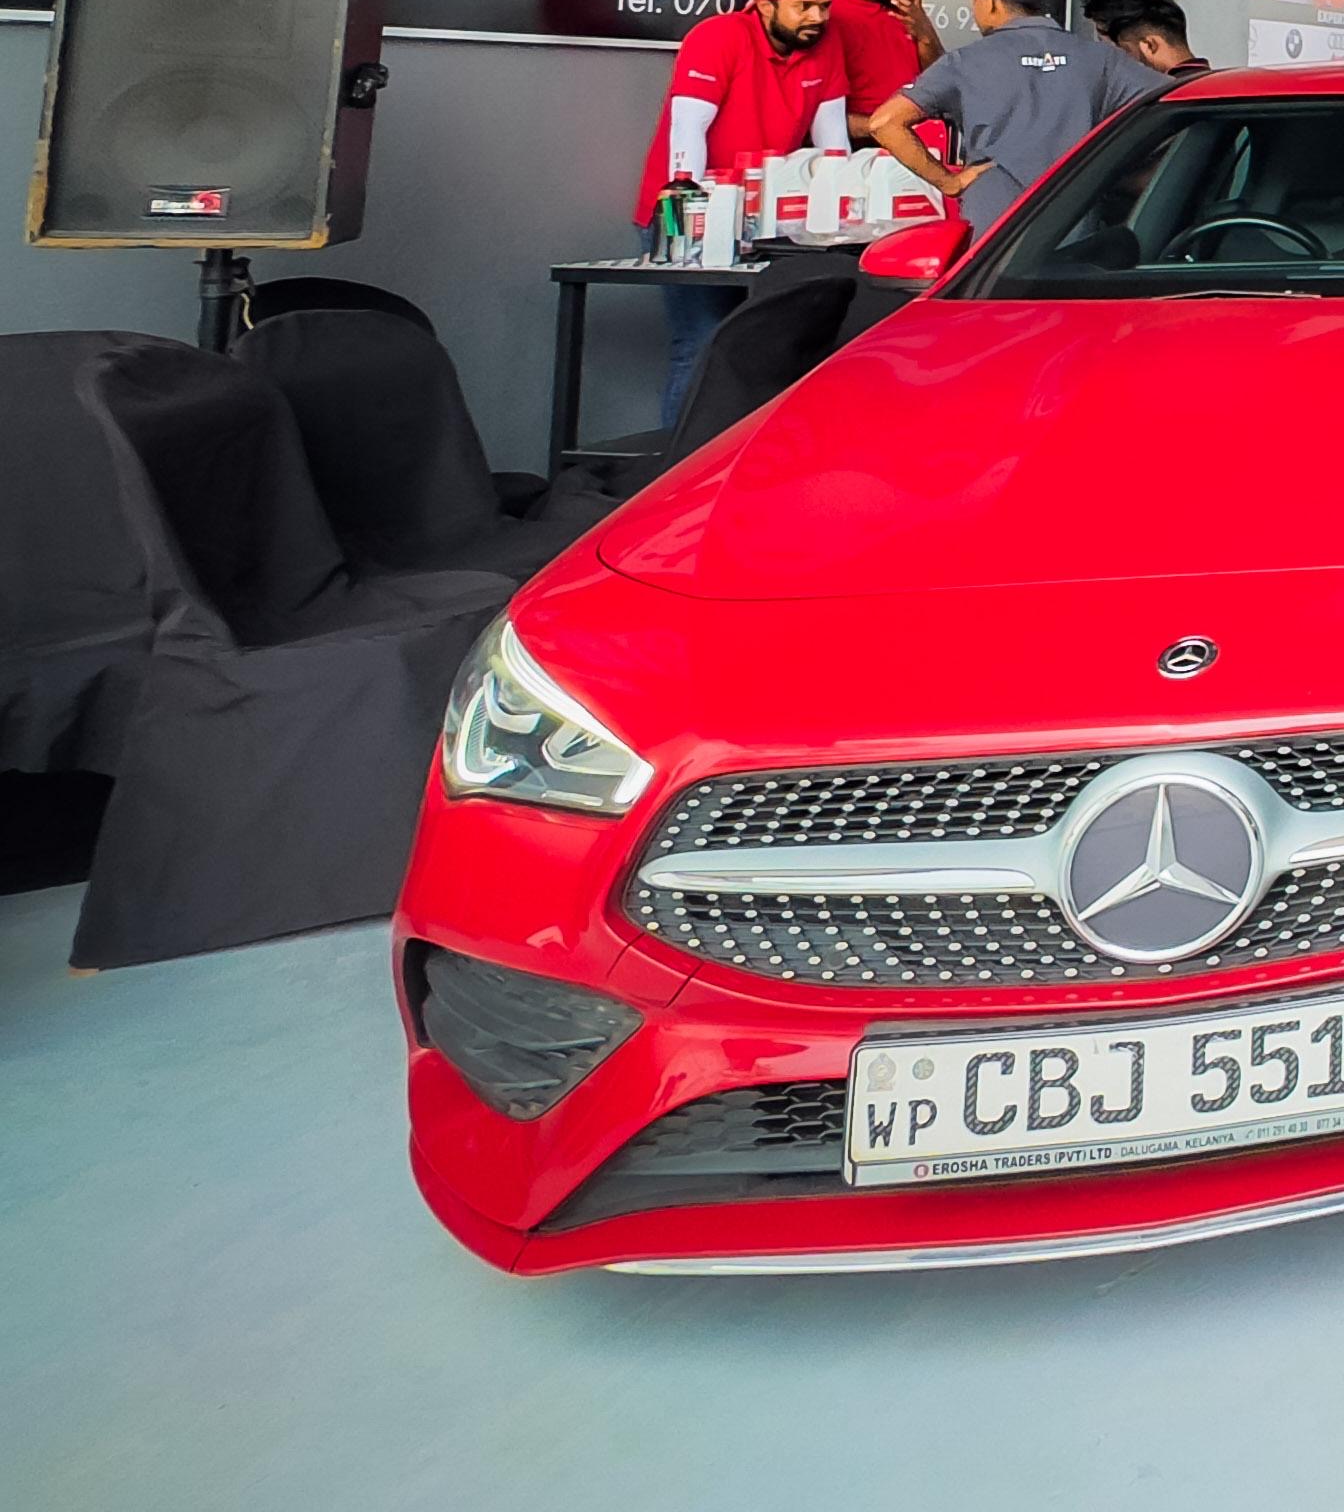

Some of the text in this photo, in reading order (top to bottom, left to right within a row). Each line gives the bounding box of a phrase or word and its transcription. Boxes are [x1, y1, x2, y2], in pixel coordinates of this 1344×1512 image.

[963, 1040, 1145, 1136] CBJ
[867, 1099, 938, 1149] WP
[932, 1158, 988, 1176] EROSHA
[994, 1152, 1051, 1169] TRADERS
[1054, 1148, 1087, 1164] (PVT)
[1089, 1147, 1112, 1161] LTD
[1185, 1132, 1235, 1148] KELANIYA
